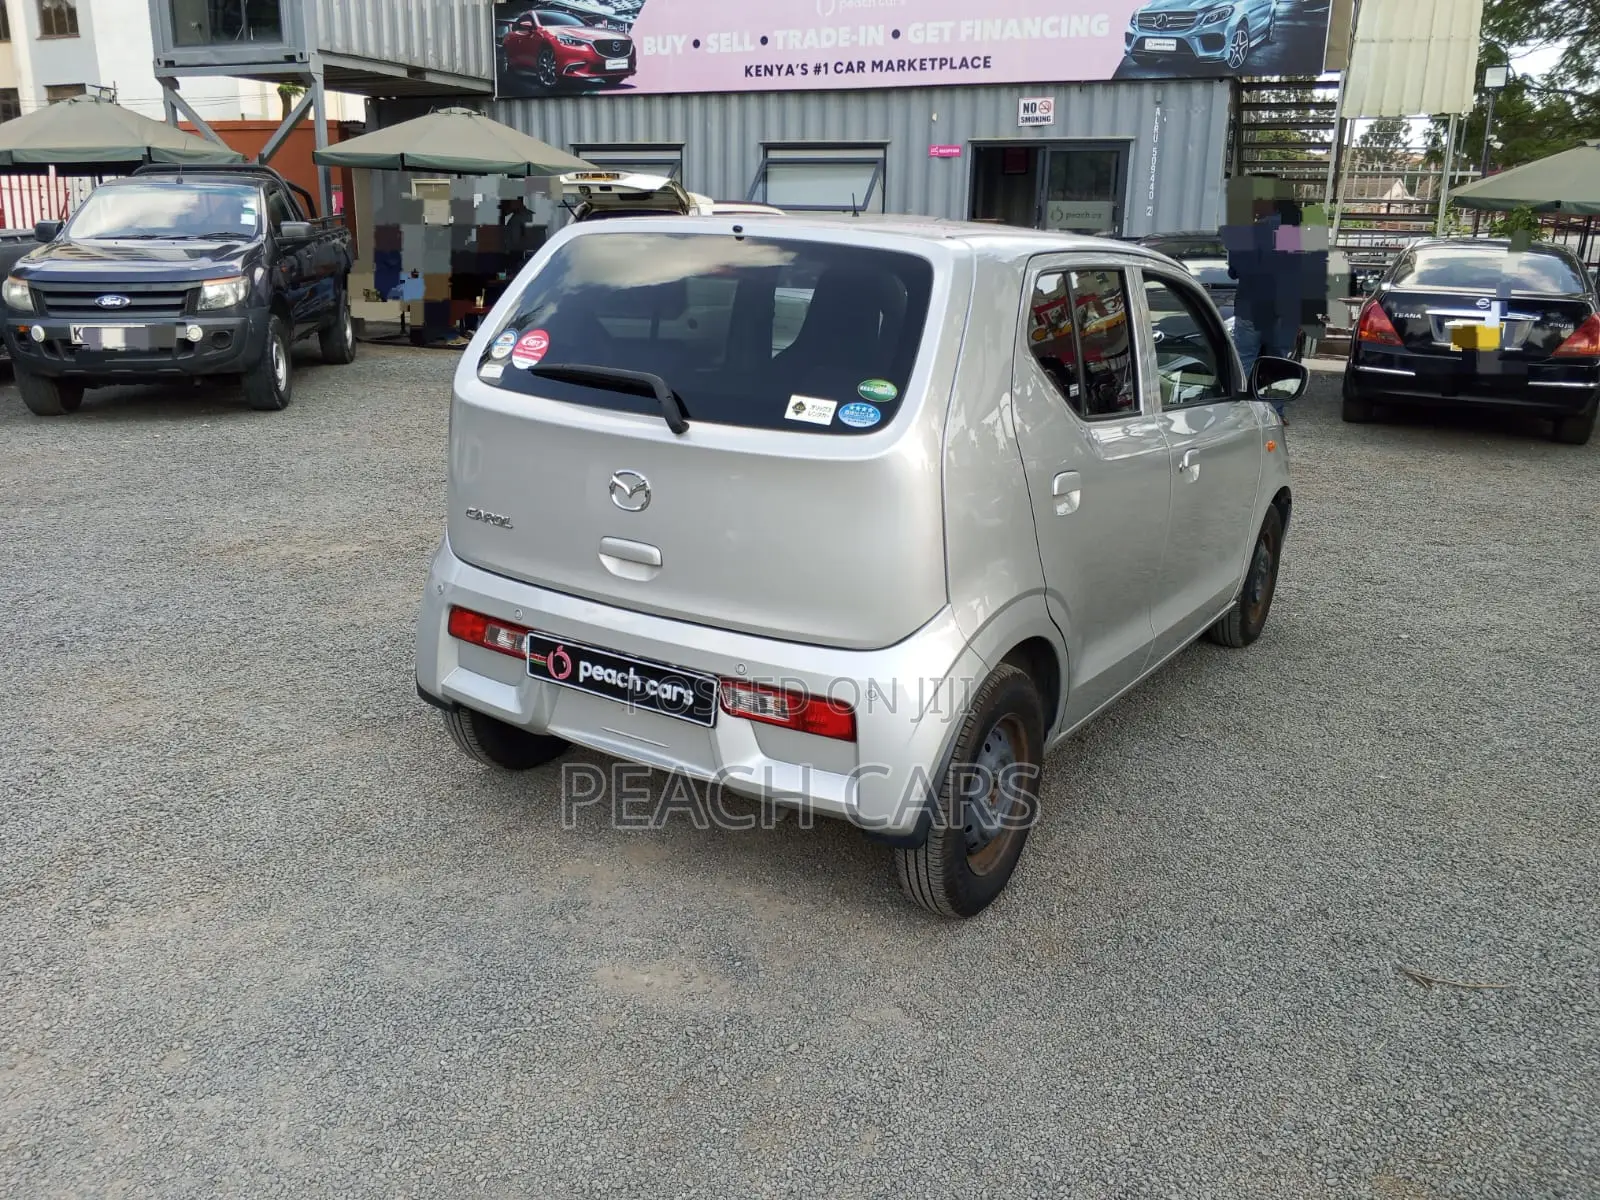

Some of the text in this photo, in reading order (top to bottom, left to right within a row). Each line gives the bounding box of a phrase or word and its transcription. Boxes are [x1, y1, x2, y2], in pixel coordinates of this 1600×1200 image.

[643, 13, 1111, 56] BUY SELL TRADE-IN GET FINANCING
[813, 61, 830, 76] #1
[833, 60, 867, 75] CAR
[871, 55, 993, 74] MARKETPLACE
[1023, 102, 1037, 114] NO
[1020, 115, 1052, 124] SMOKING
[101, 296, 122, 305] Ford
[1393, 312, 1423, 321] TEANA
[466, 507, 514, 530] CAROL
[578, 659, 694, 706] peach cars
